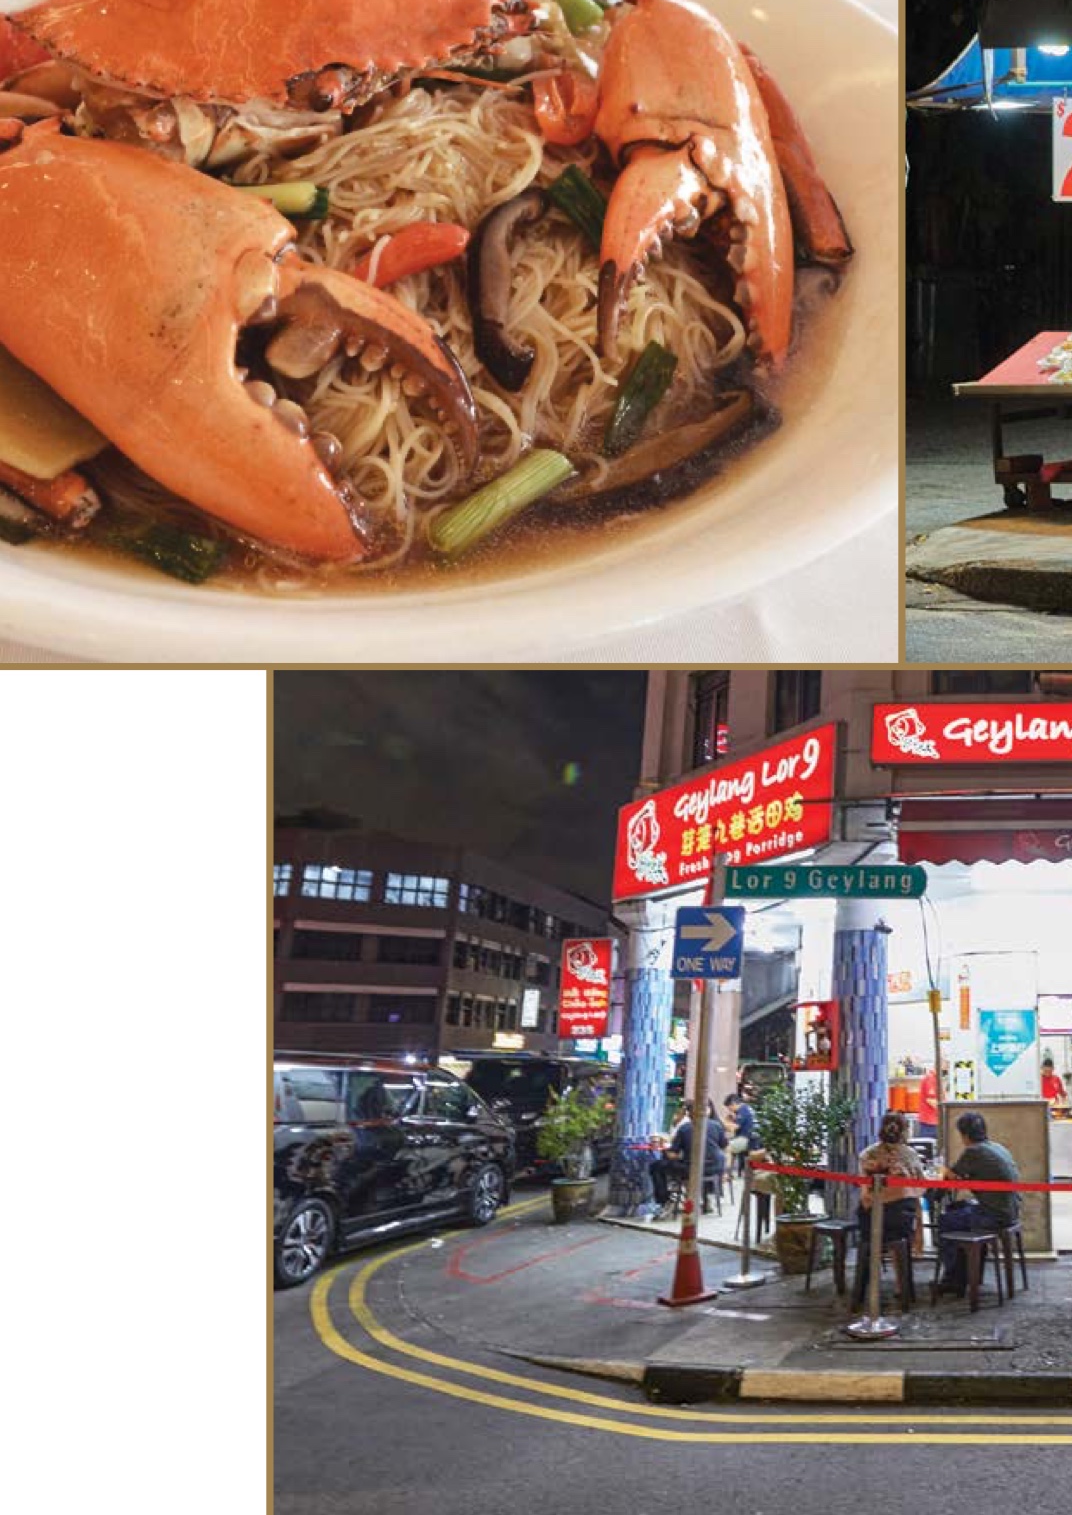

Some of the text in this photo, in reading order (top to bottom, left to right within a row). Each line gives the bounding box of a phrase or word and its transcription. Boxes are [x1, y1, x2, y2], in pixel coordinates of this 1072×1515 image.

[673, 770, 756, 824] Geylang
[679, 856, 709, 876] Fresh
[745, 830, 804, 857] Porridge
[731, 869, 914, 894] Lor 9 Geylang
[675, 956, 737, 972] ONE WAY
